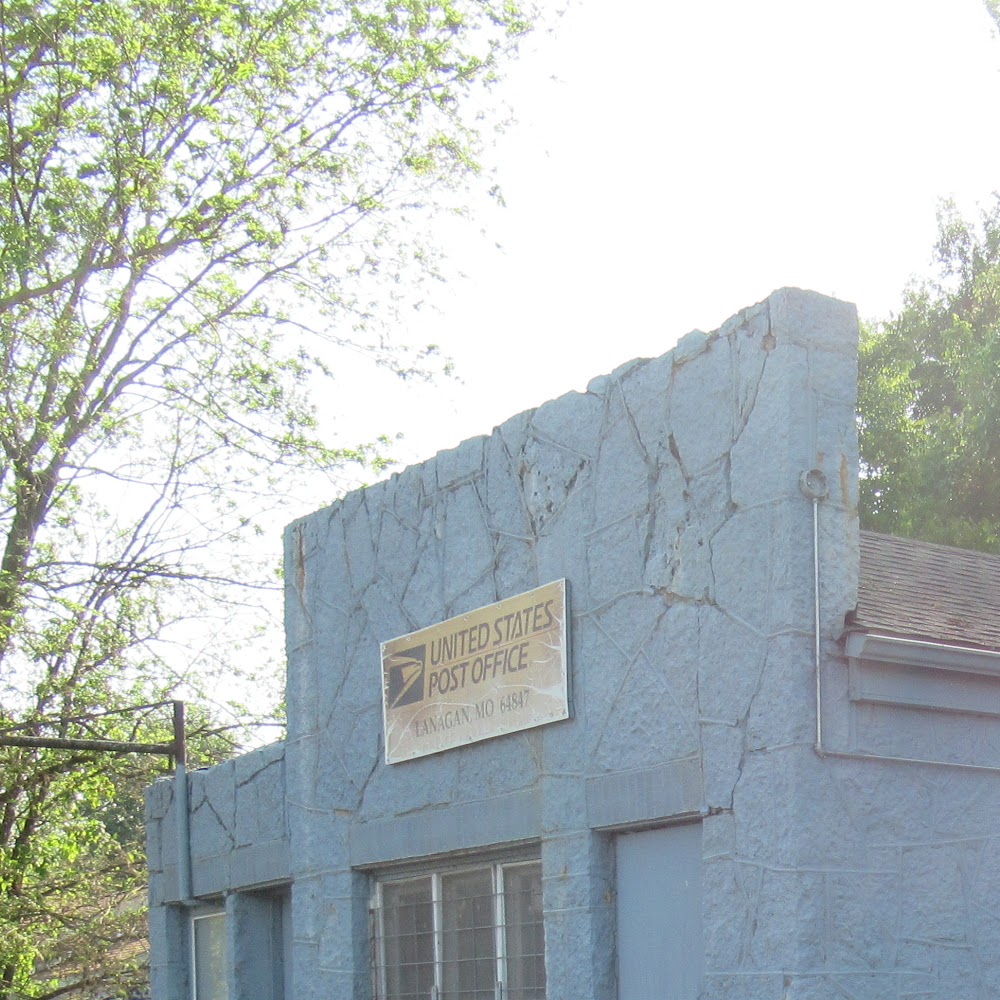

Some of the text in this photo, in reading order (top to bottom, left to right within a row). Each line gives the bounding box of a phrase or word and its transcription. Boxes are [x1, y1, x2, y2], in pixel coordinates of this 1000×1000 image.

[430, 600, 554, 666] UNITED STATES
[428, 641, 530, 698] POST OFFICE
[474, 699, 495, 720] MO
